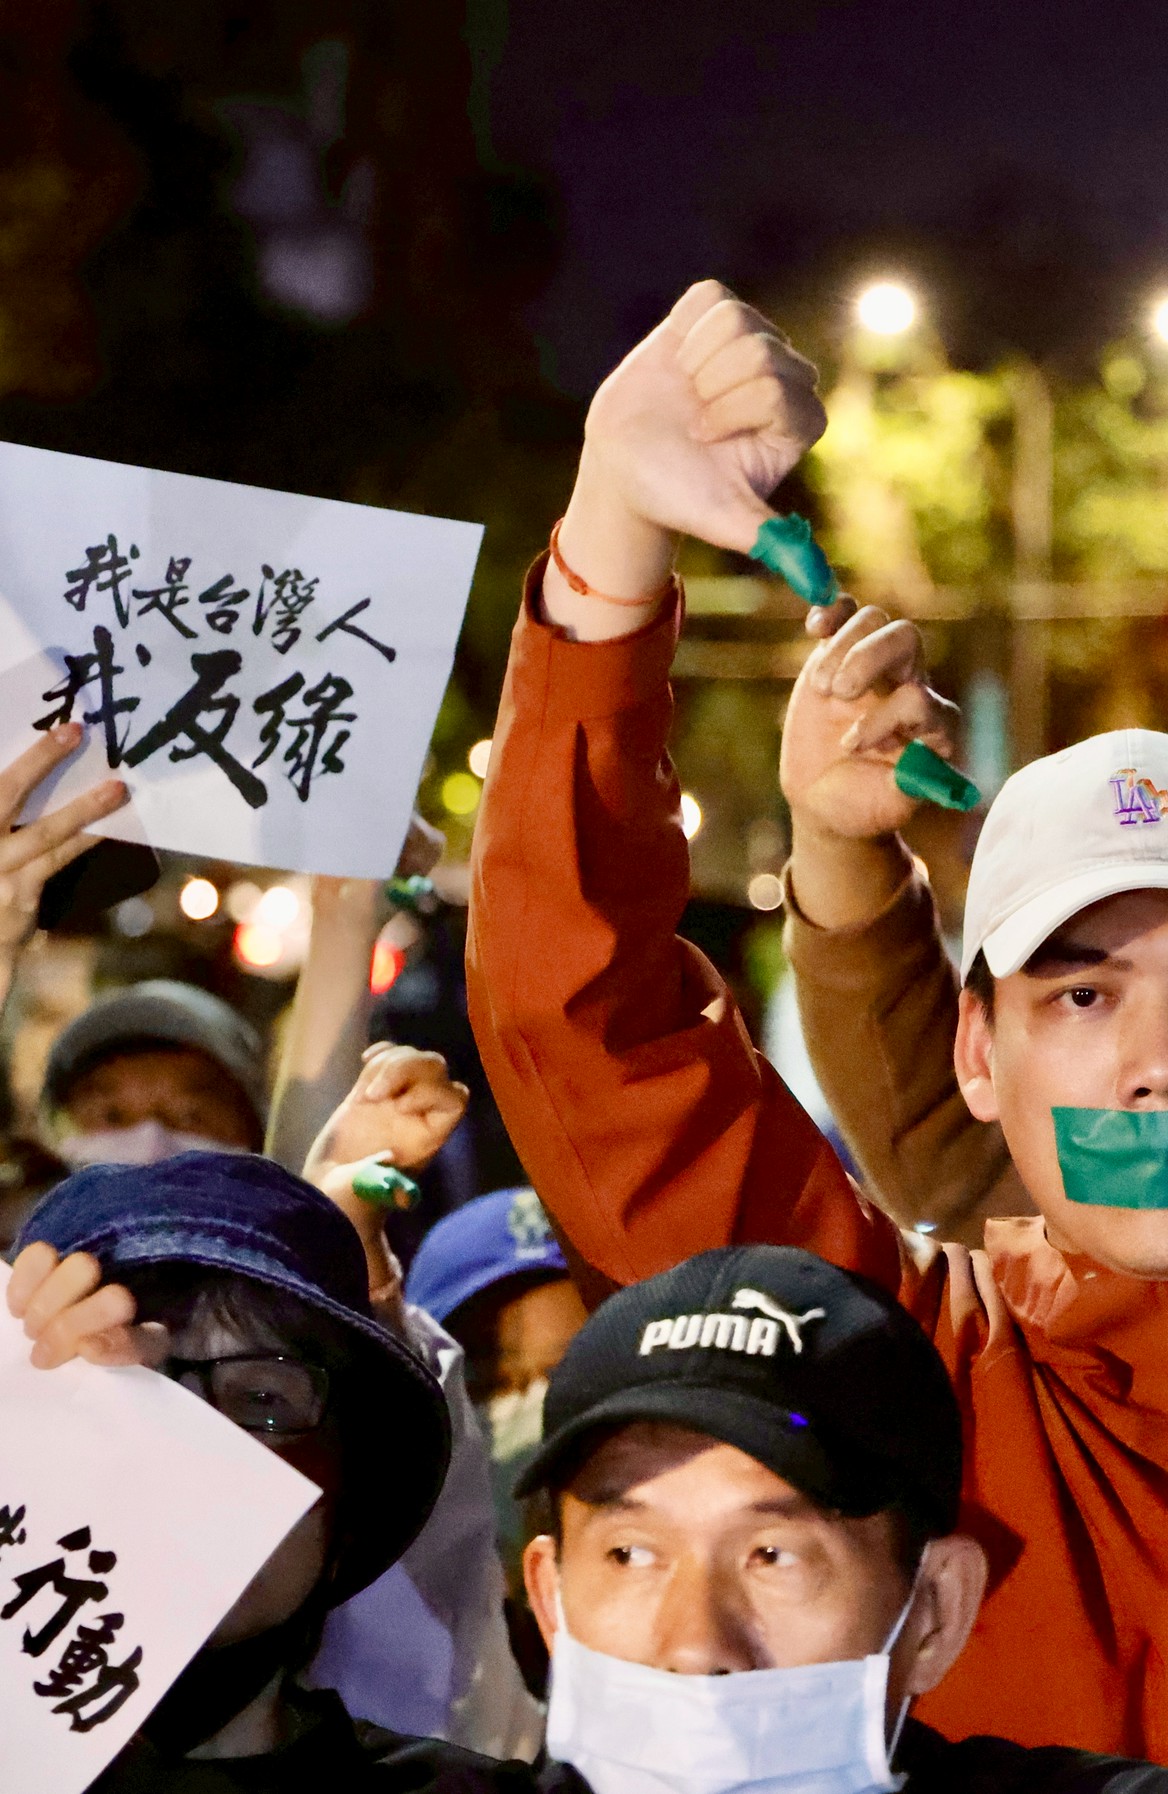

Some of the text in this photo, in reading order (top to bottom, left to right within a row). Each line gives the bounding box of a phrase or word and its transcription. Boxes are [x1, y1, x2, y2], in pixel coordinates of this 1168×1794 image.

[64, 533, 396, 663] 我是台灣人
[32, 625, 358, 809] 我反綠
[638, 1313, 779, 1356] PUMA
